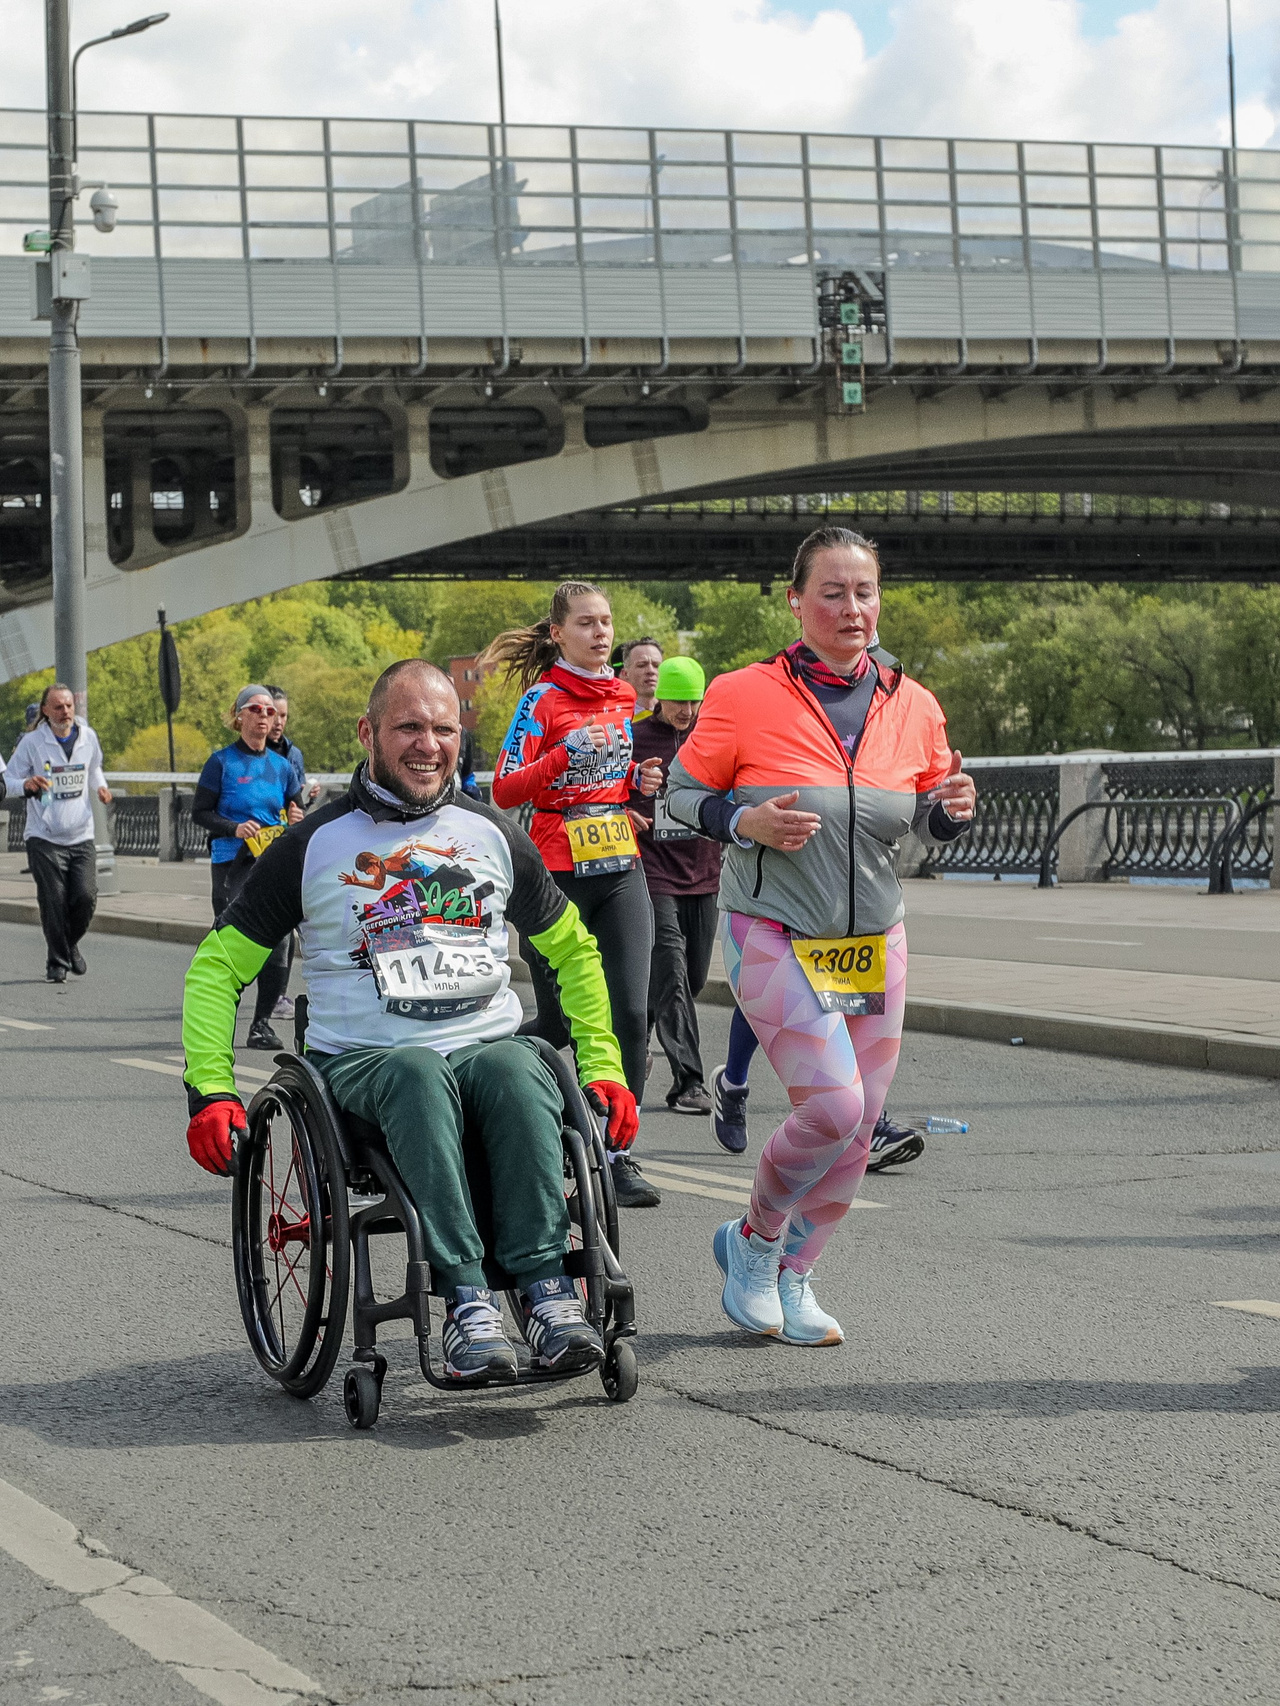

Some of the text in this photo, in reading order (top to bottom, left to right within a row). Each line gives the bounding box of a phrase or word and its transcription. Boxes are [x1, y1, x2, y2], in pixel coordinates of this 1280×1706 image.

[55, 774, 85, 786] 10302
[574, 820, 631, 847] 18130
[660, 829, 668, 839] G
[601, 845, 617, 853] АННА
[581, 861, 590, 874] F
[366, 911, 421, 931] БЕГОВОЙ КЛУБ
[809, 945, 874, 974] 2308
[389, 951, 494, 984] 11425
[434, 982, 460, 991] ИЛЬЯ
[398, 1000, 412, 1013] G
[824, 992, 832, 1008] F
